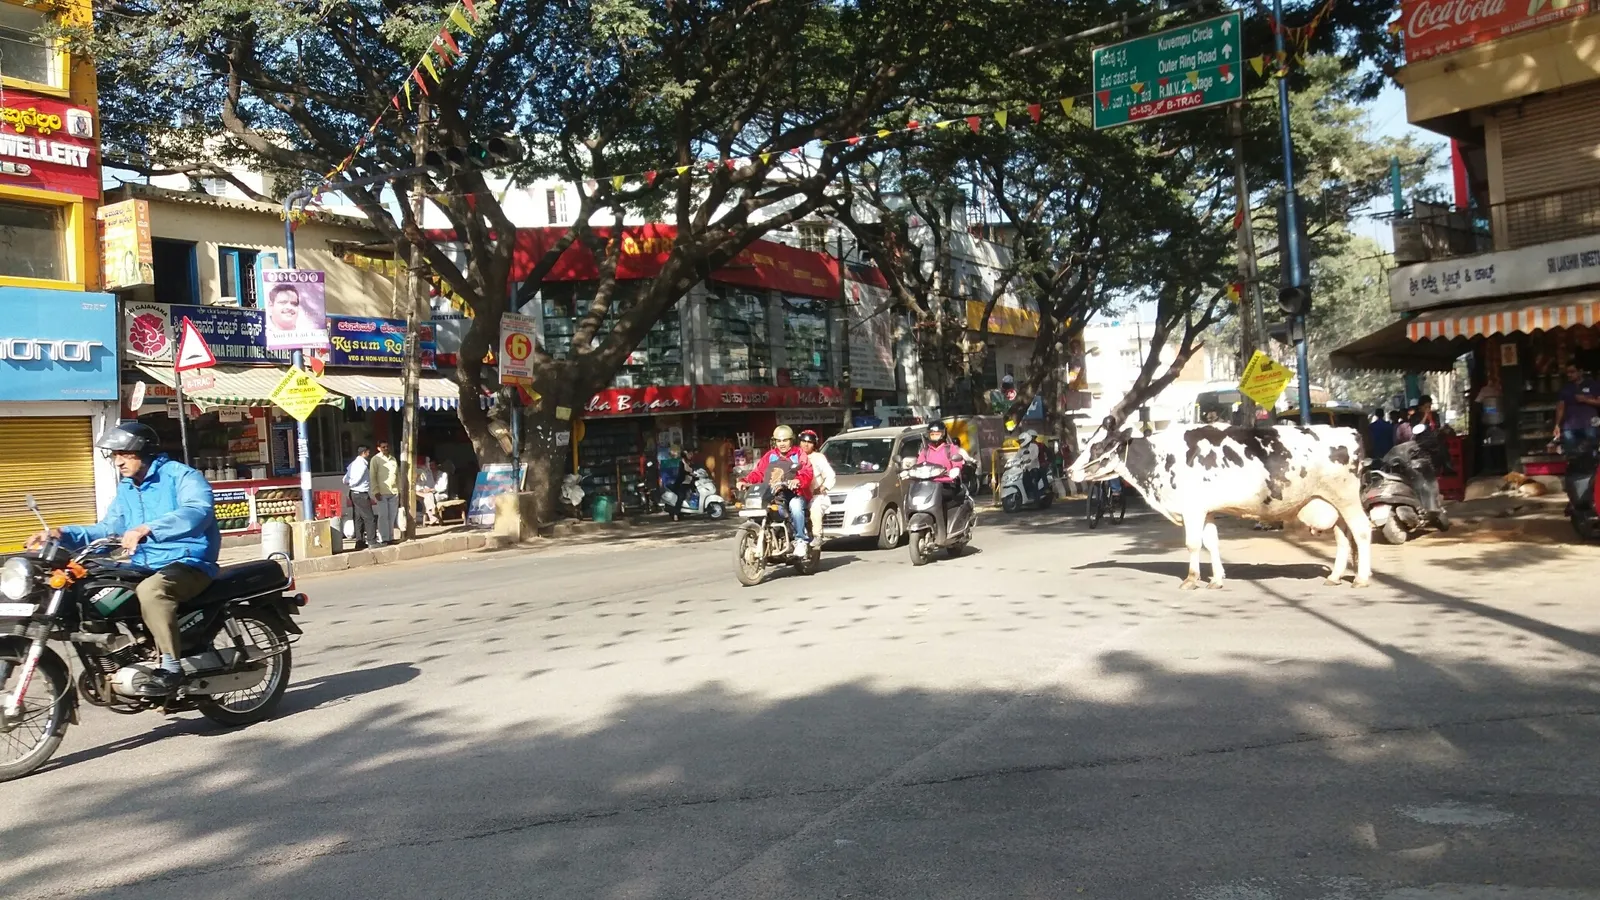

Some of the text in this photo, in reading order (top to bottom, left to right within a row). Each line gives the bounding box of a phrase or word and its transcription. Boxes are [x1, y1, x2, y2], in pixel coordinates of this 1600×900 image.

[1158, 27, 1213, 51] Kuvempu Circle
[1159, 48, 1217, 74] Outer Ring Road
[1166, 94, 1201, 110] B-TRAC
[1580, 249, 1600, 269] SWEET
[135, 304, 168, 317] GAJANANA
[226, 344, 246, 358] FRUIT
[246, 345, 265, 359] JUICE
[331, 336, 380, 353] Kusum
[512, 334, 528, 360] 6
[186, 376, 212, 388] B-TRAC
[617, 395, 680, 413] Bazaar
